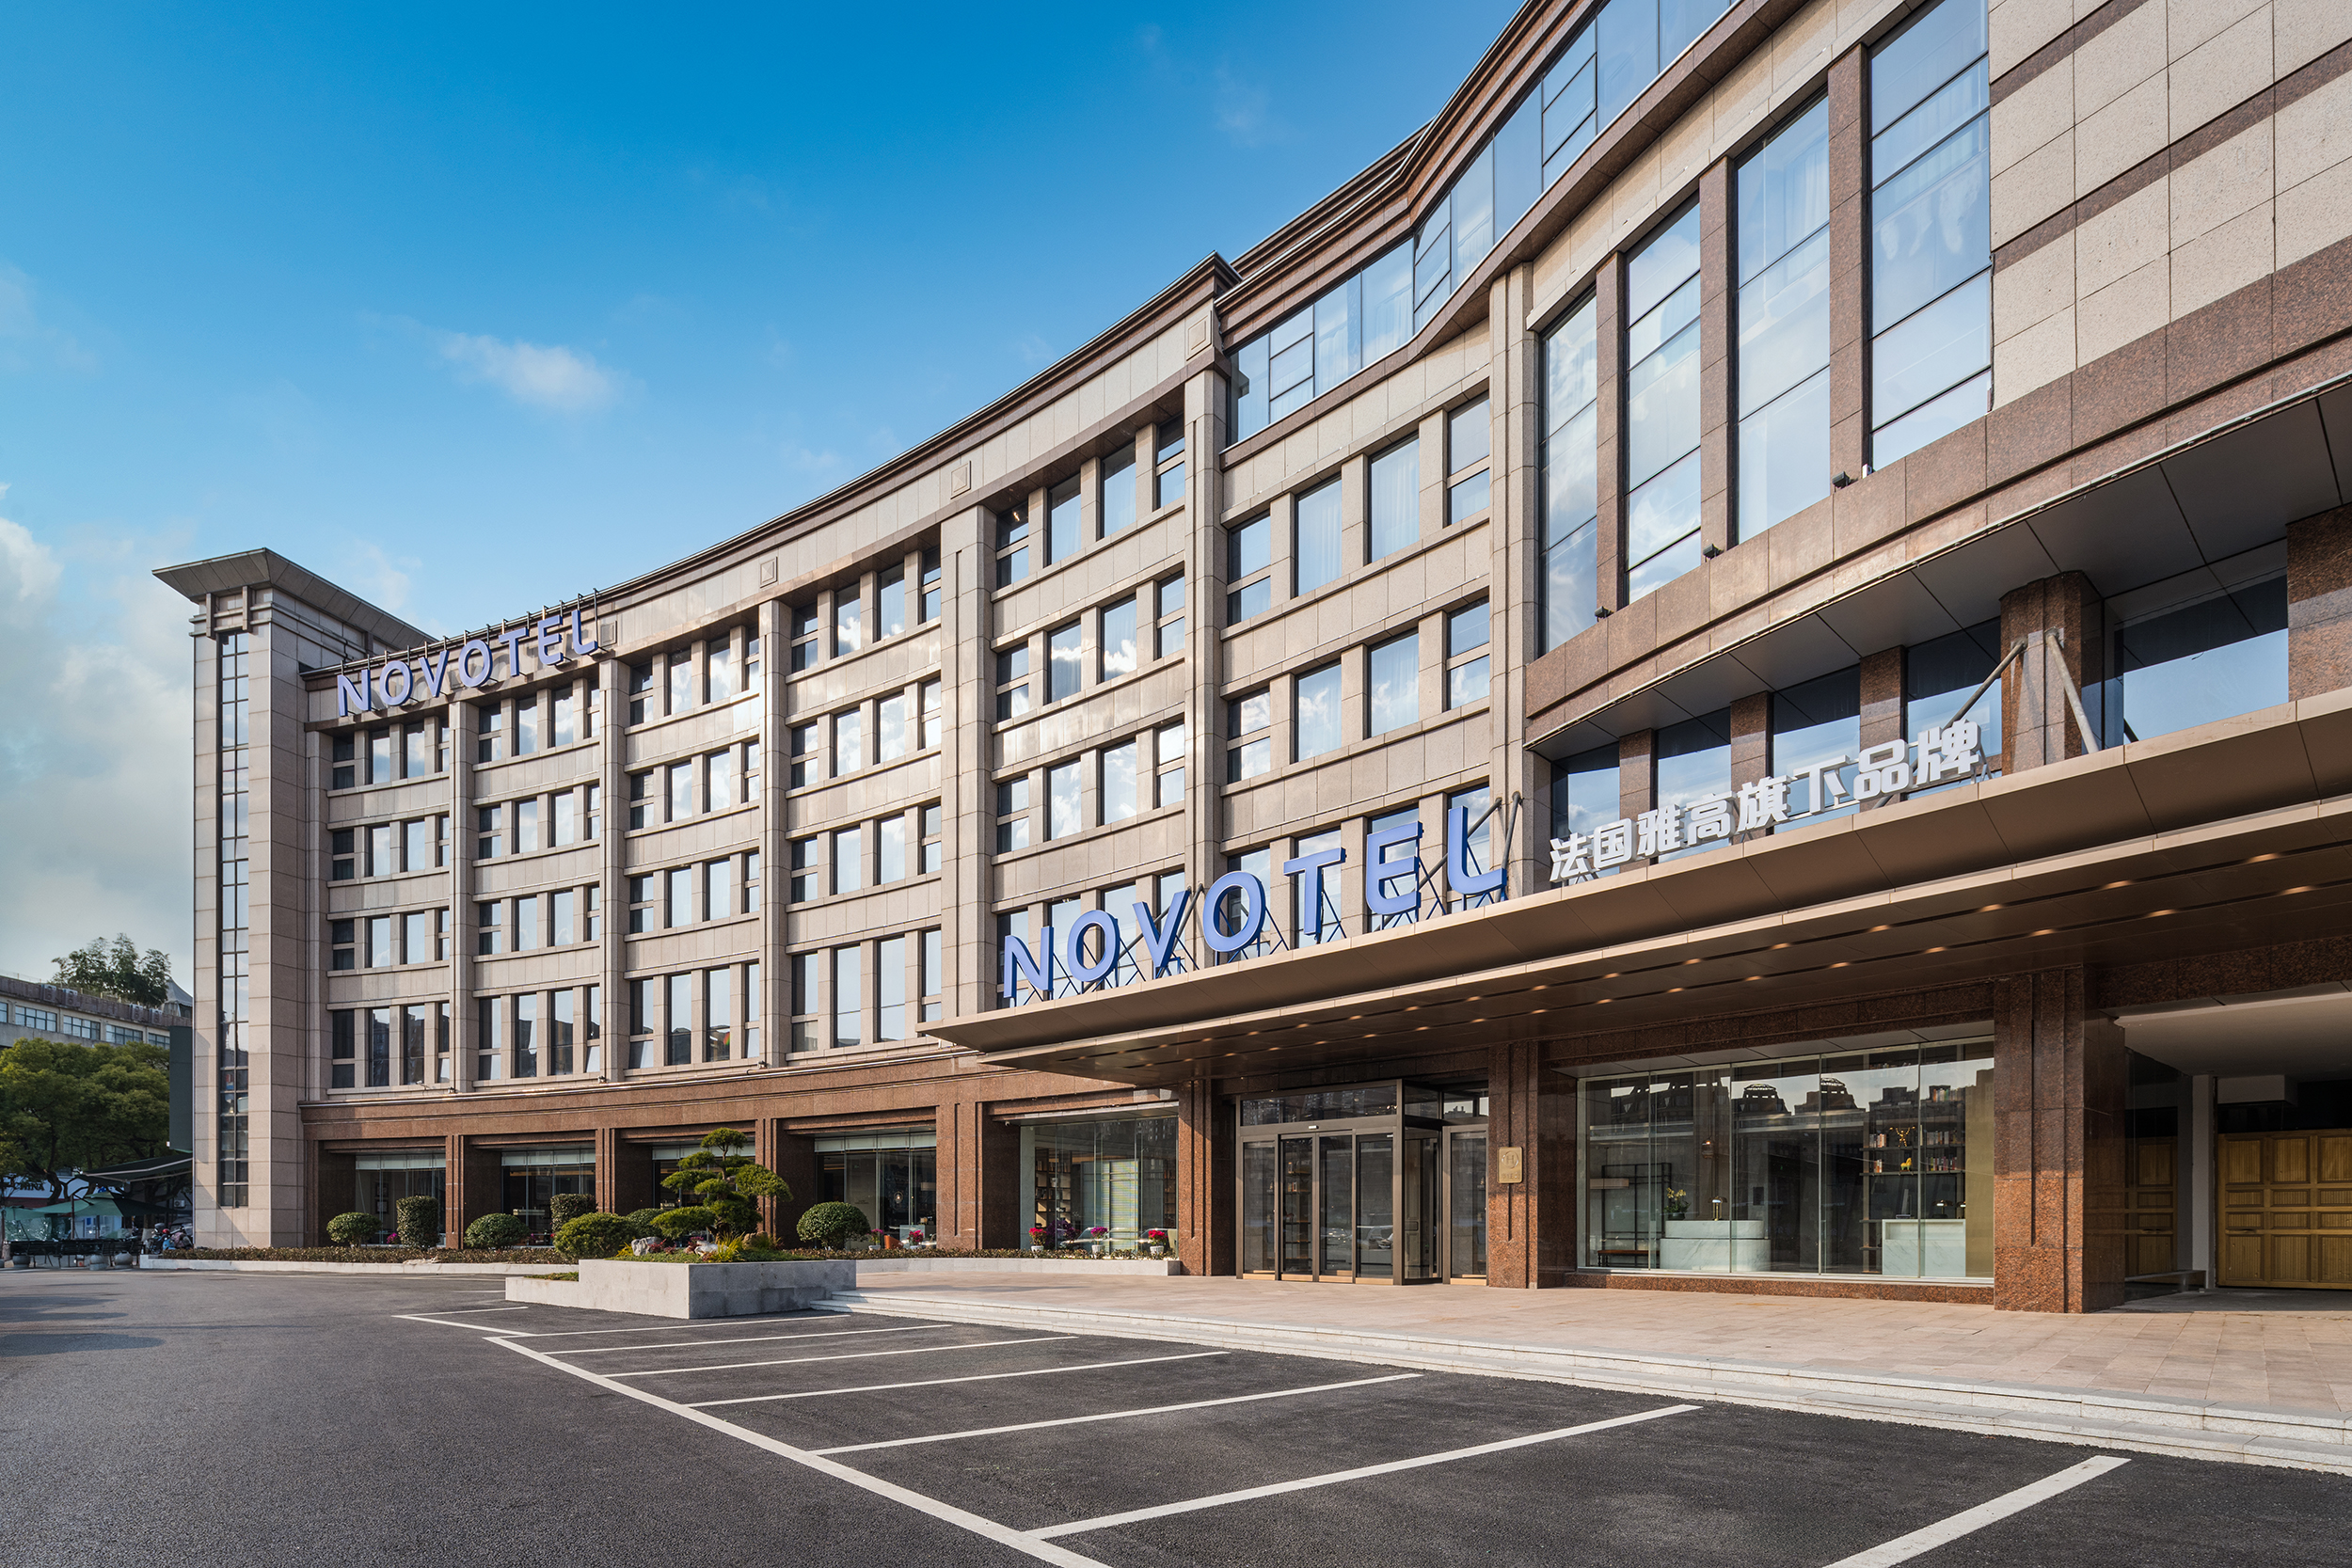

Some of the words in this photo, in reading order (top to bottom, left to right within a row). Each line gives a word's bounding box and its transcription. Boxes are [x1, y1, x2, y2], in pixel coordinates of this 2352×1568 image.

[337, 610, 598, 717] NOVOTEL
[1549, 719, 1981, 883] 法国雅高旗下品牌
[1004, 805, 1505, 999] NOVOTEL
